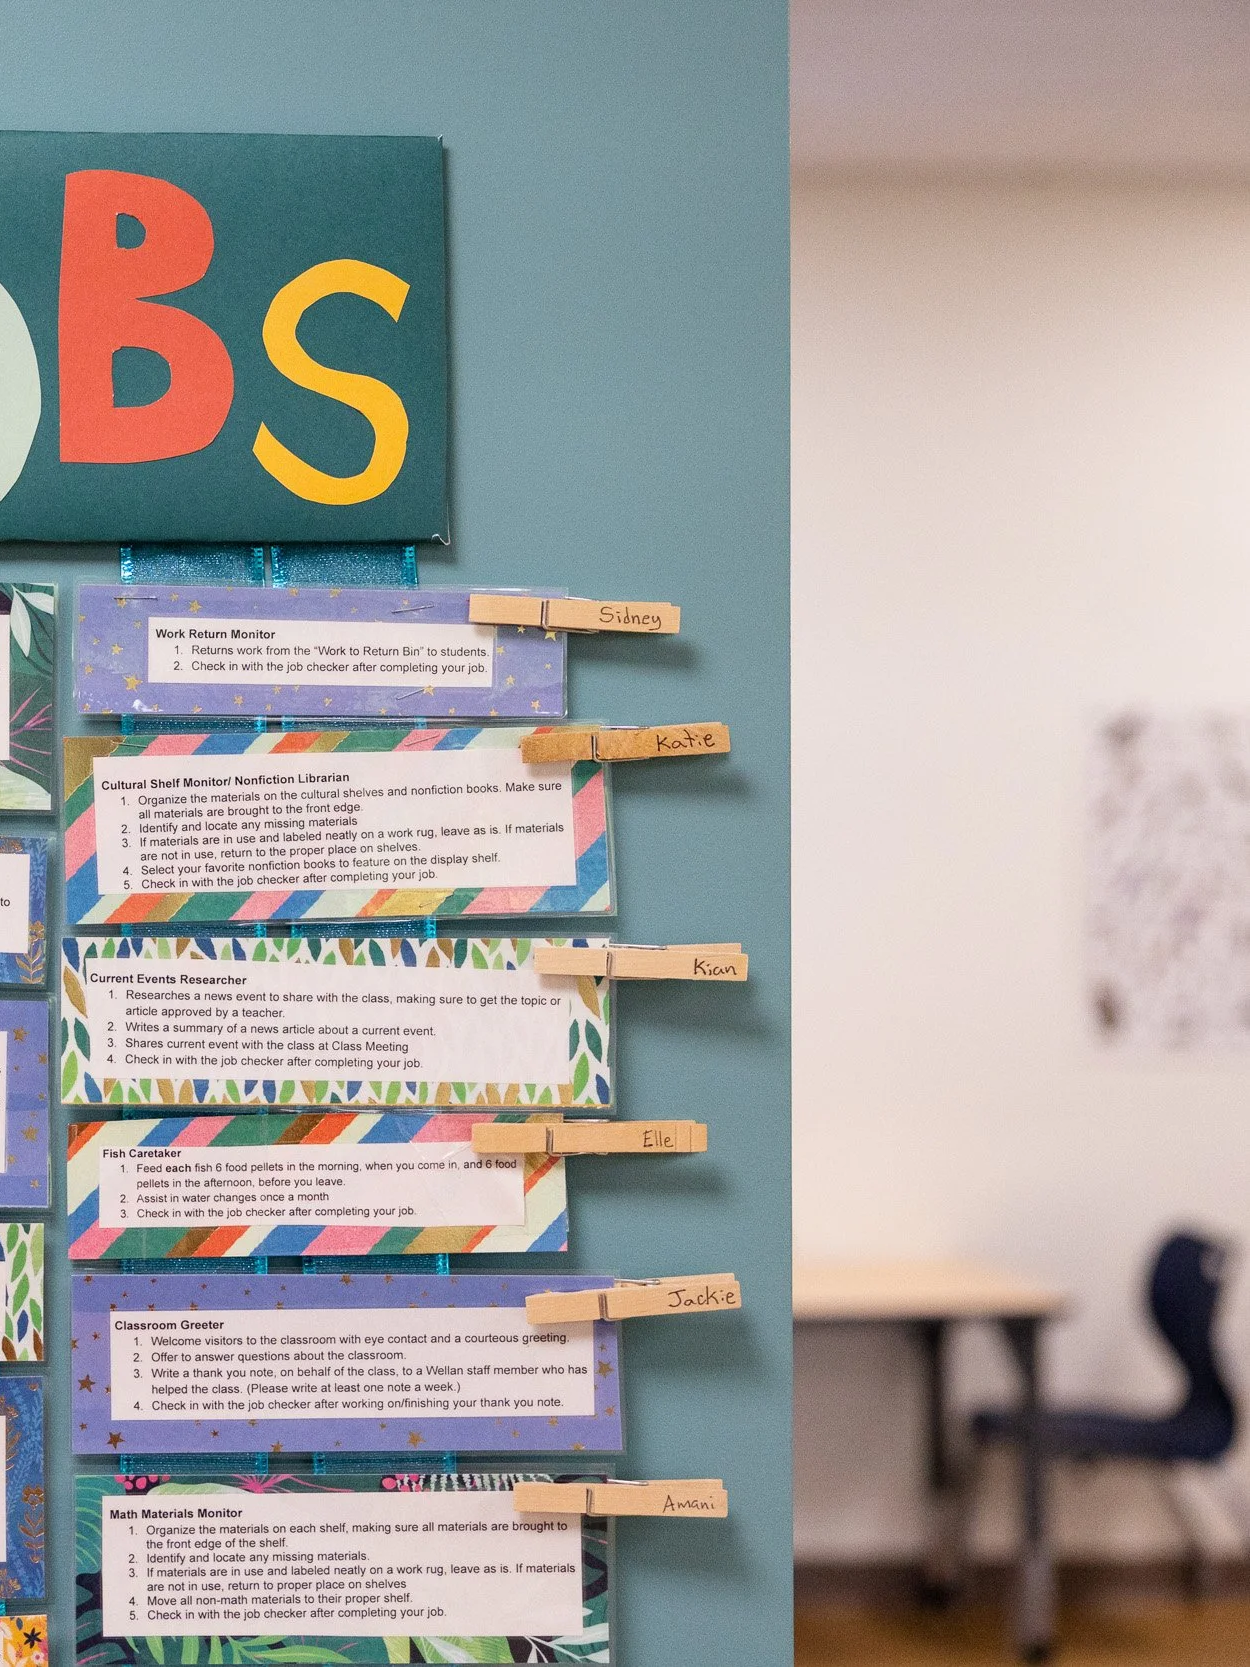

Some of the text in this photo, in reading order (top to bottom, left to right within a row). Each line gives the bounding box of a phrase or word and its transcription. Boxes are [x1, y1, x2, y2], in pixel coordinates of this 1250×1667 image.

[599, 606, 662, 631] Sidney
[154, 627, 276, 640] Work Return Monitor
[173, 644, 489, 657] 1. Returns work from the “Work to Return Bin” to students.
[656, 729, 715, 752] Katie
[100, 771, 350, 791] Cultural Shelf Monitor/ Nonfiction Librarian
[120, 815, 358, 835] 2. Identify and locate any missing materials
[694, 958, 737, 976] Kian
[89, 972, 247, 985] Current Events Researcher
[106, 1036, 409, 1054] 3. Shares current event with the class at Class Meeting
[643, 1130, 674, 1147] Elle
[102, 1148, 182, 1158] Fish Caretaker
[119, 1191, 330, 1204] 2. Assist in water changes once a month
[667, 1286, 736, 1307] Jackie
[113, 1318, 225, 1331] Classroom Greeter
[132, 1349, 406, 1364] 2. Offer to answer questions about the classroom.
[662, 1495, 714, 1513] Amani
[109, 1507, 243, 1520] Math Materials Monitor
[127, 1591, 413, 1606] 4. Move all non-math materials to their proper shelf.
